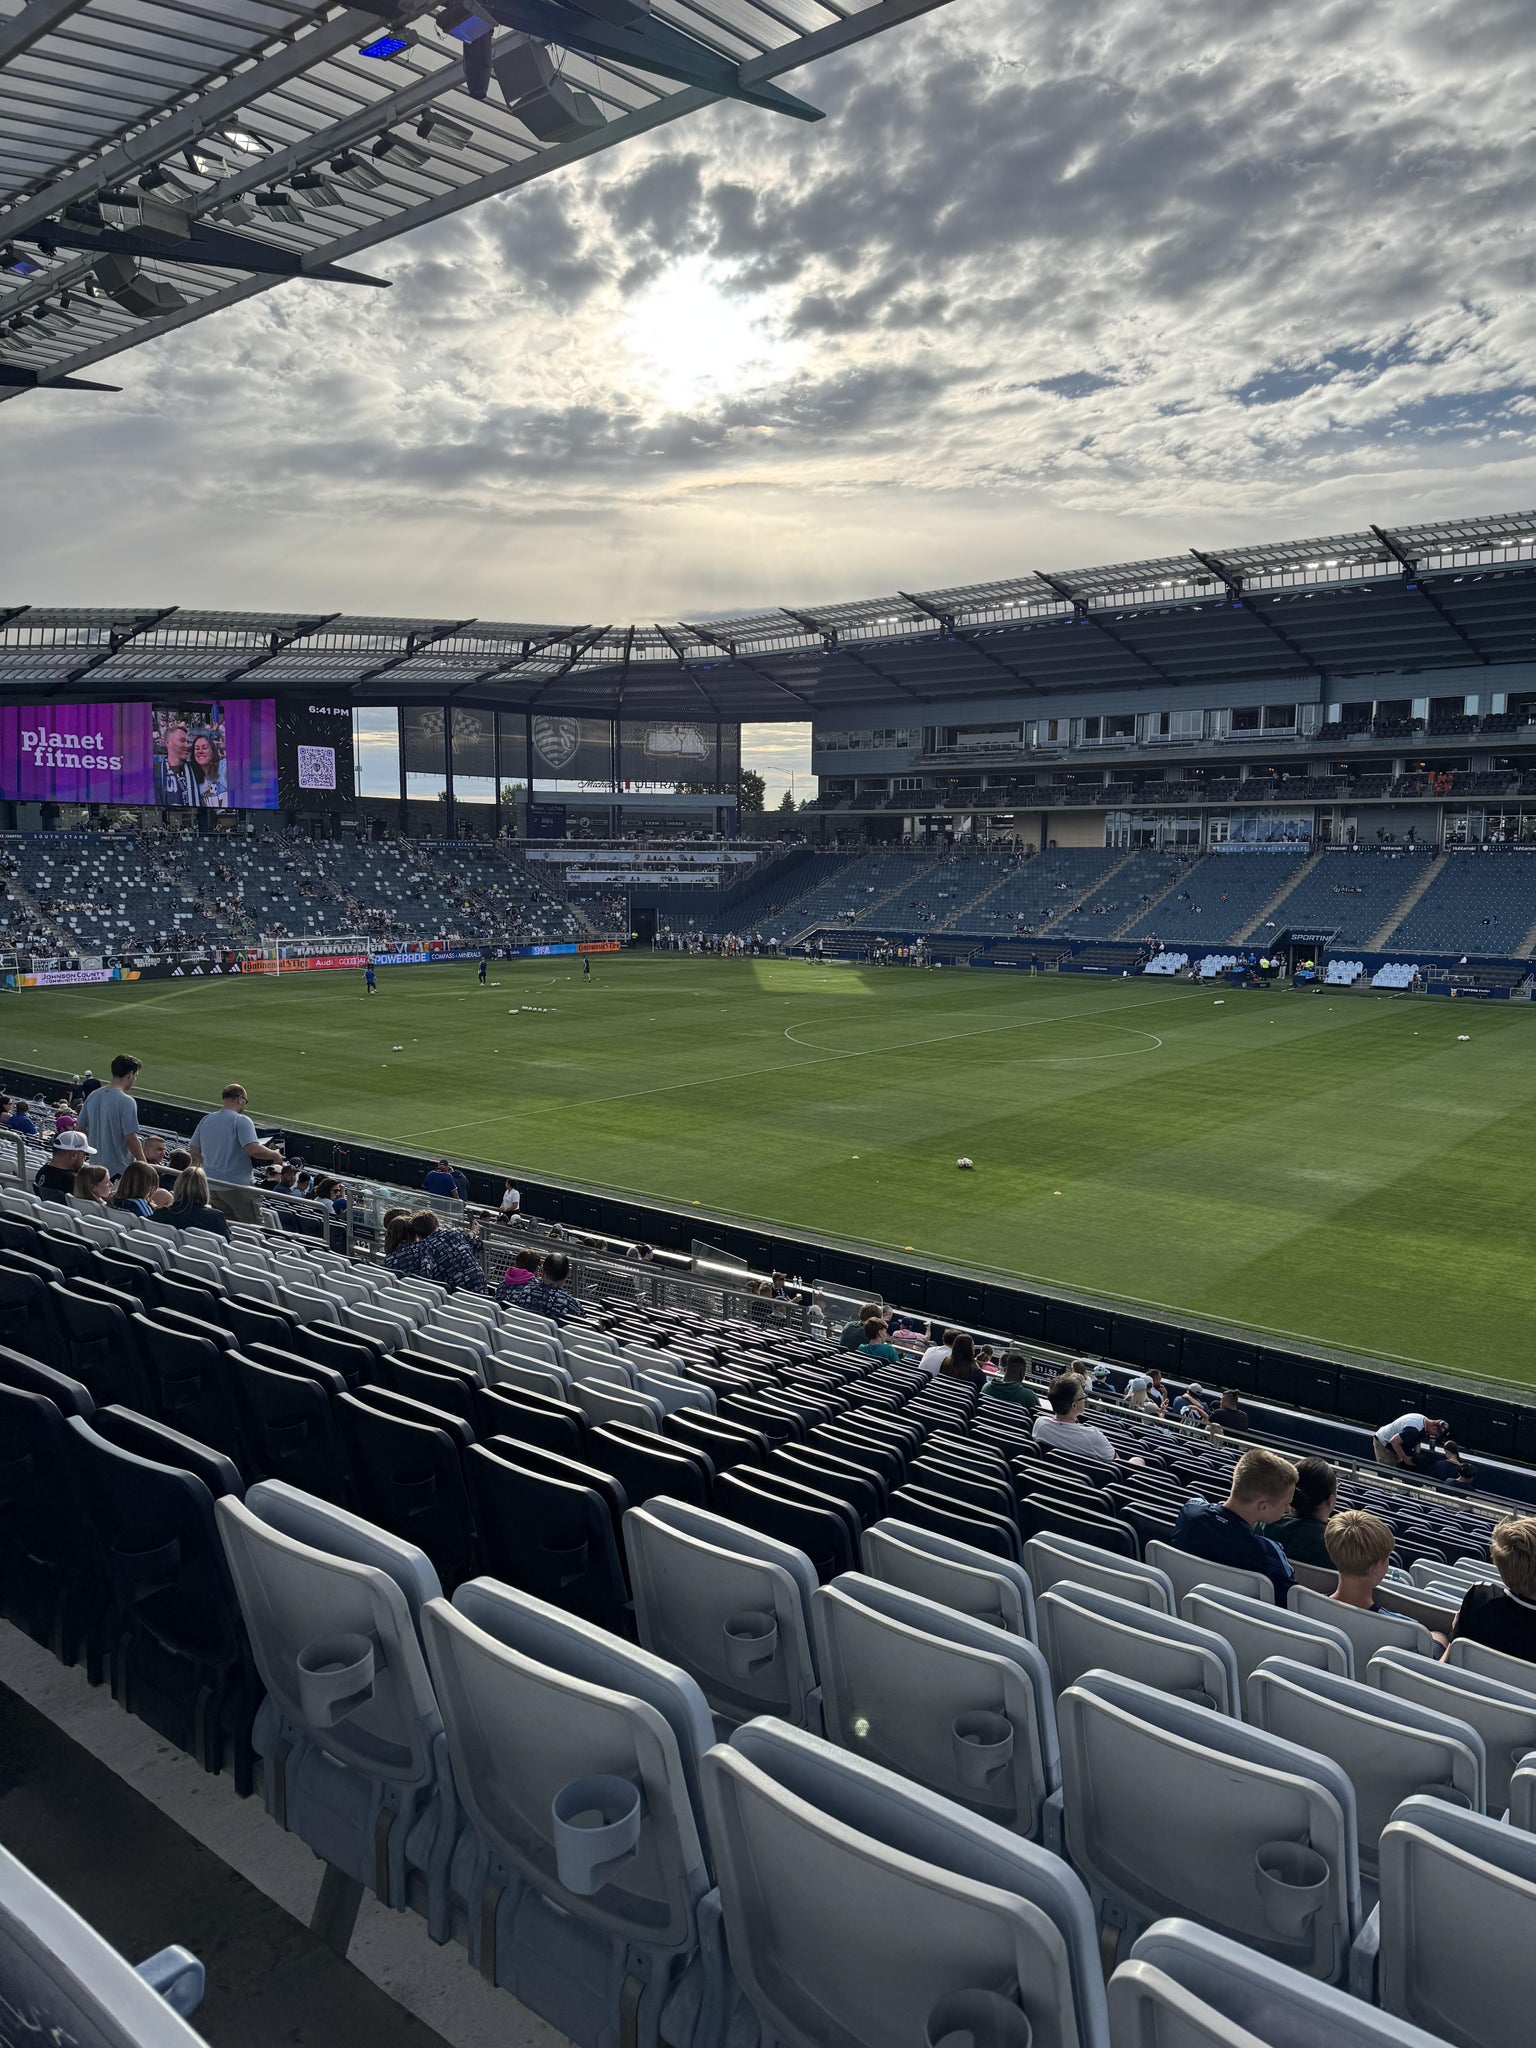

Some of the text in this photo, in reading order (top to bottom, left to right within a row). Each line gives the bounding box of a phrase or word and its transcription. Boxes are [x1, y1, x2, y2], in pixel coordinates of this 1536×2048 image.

[308, 705, 349, 717] 6:41 PM
[21, 726, 104, 752] planet
[34, 746, 122, 771] fitness
[374, 952, 427, 964] POWERADE
[431, 952, 455, 960] COMPASS
[315, 959, 334, 967] Audi
